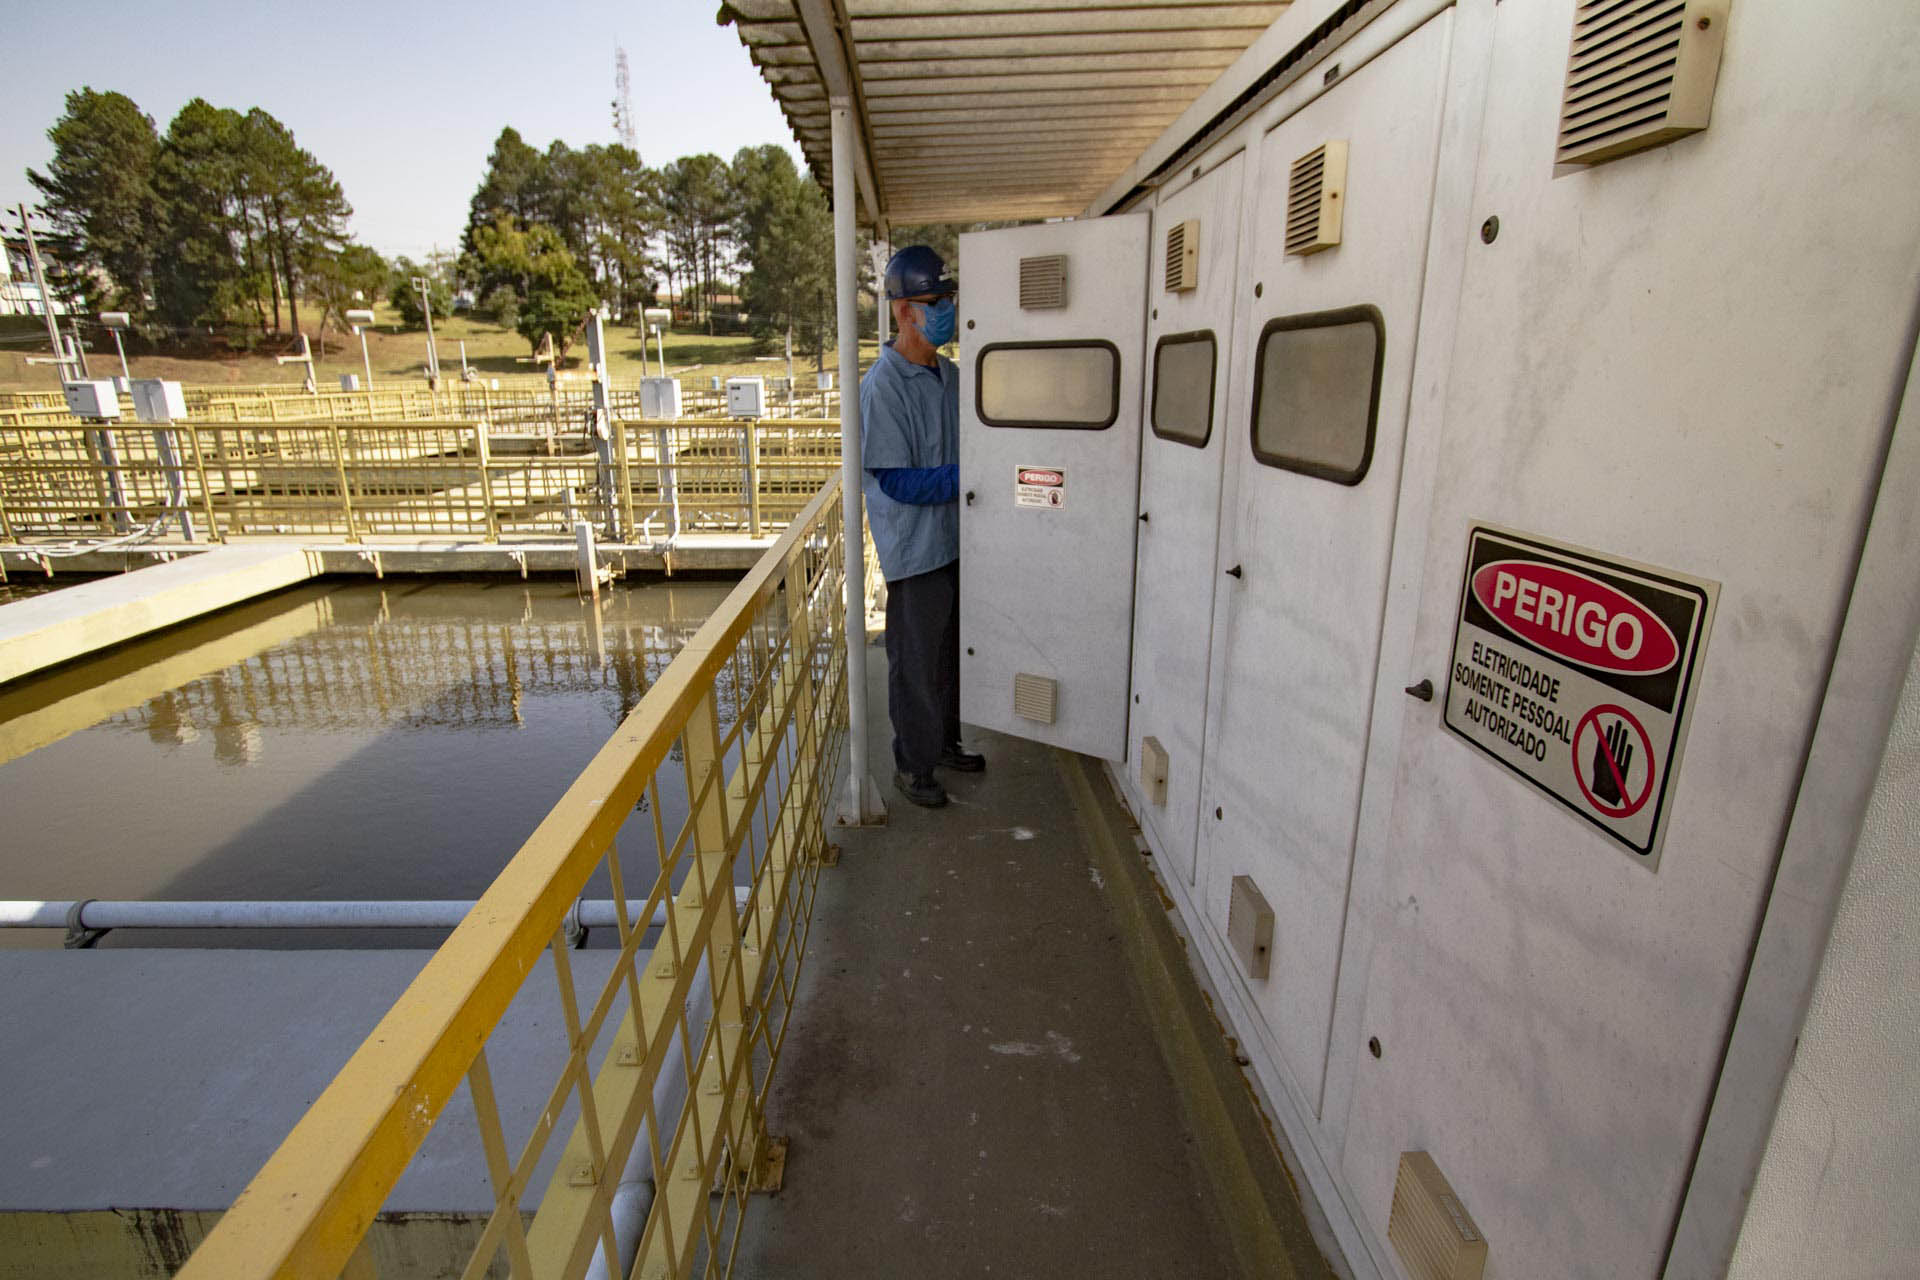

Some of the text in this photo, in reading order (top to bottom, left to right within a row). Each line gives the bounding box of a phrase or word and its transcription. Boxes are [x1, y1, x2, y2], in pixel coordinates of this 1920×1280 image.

[1024, 473, 1057, 482] PERIGO
[1493, 571, 1643, 660] PERIGO
[1455, 662, 1571, 745] SOMENTE PESSOAL
[1472, 642, 1560, 703] ELETRICIDADE
[1464, 698, 1547, 762] AUTORIZADO
